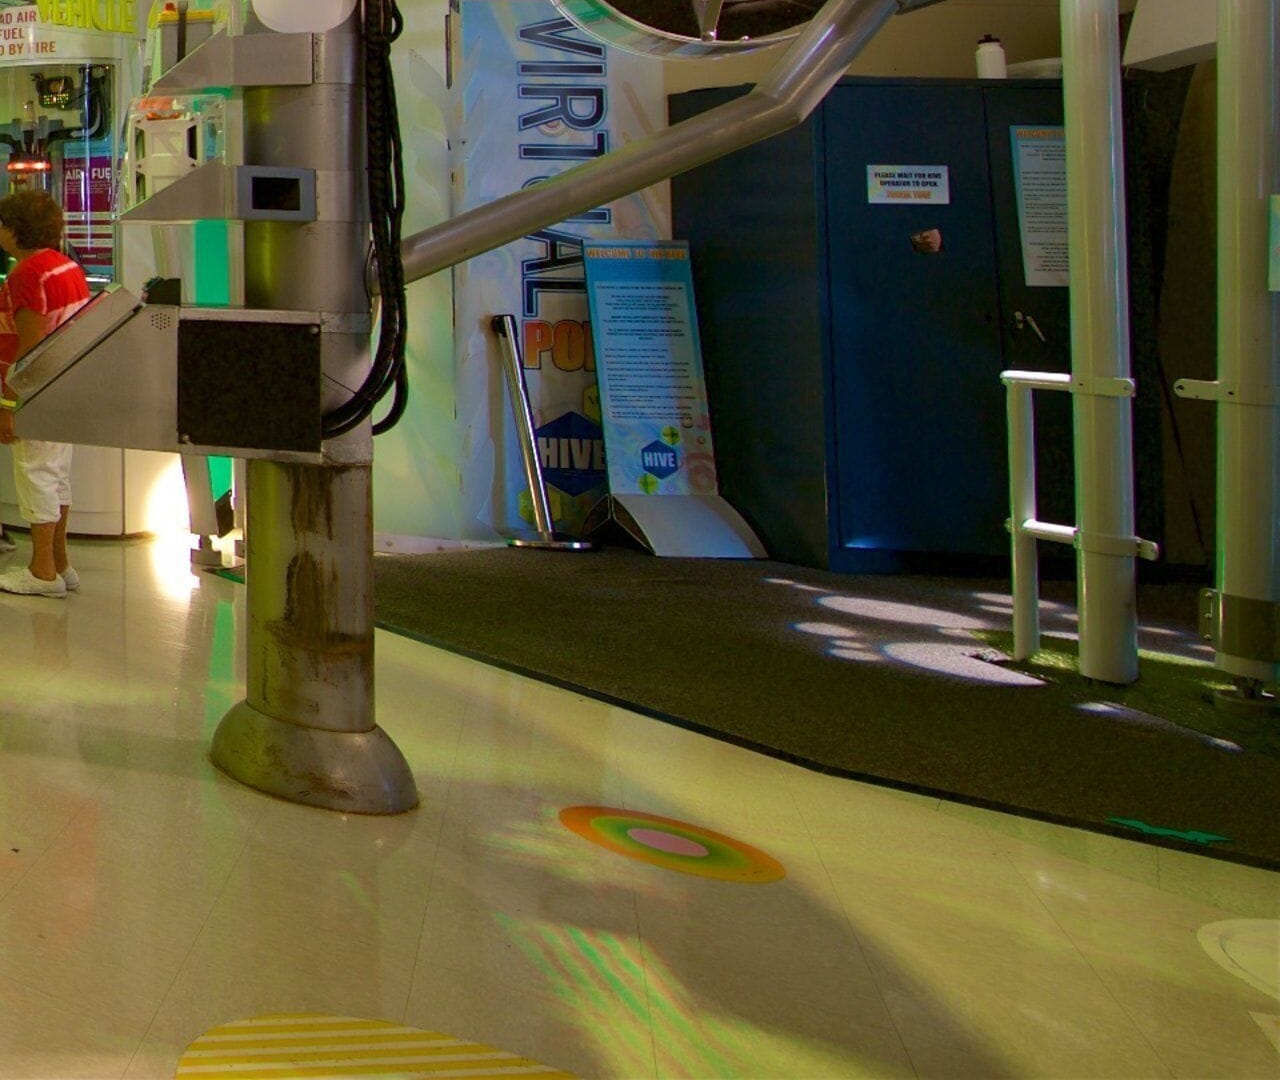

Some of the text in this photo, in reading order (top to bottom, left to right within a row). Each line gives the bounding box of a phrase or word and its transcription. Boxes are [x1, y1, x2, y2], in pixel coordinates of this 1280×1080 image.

[17, 10, 37, 23] AIR
[9, 43, 24, 55] BY
[643, 451, 676, 468] HIVE
